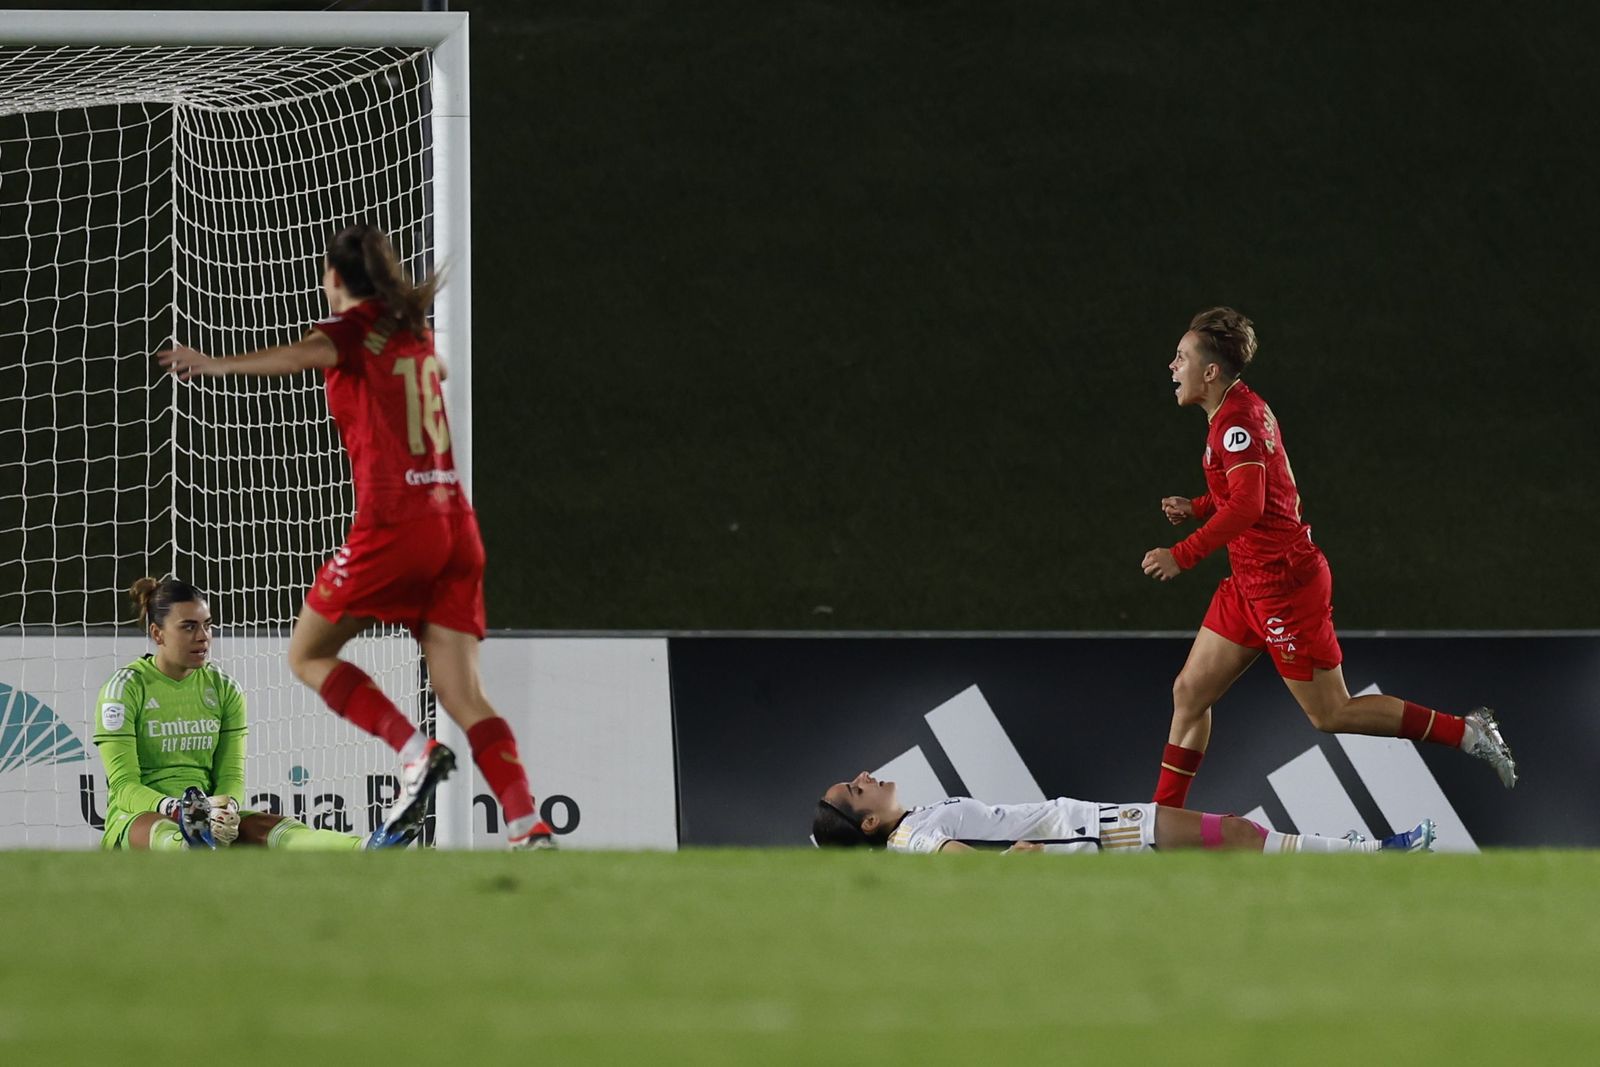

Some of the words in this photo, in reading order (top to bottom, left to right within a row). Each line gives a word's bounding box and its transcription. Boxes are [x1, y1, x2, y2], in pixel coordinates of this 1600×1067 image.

[1228, 431, 1247, 448] JD
[147, 717, 220, 738] Emirates
[161, 737, 178, 753] FLY
[180, 735, 213, 751] BETTER
